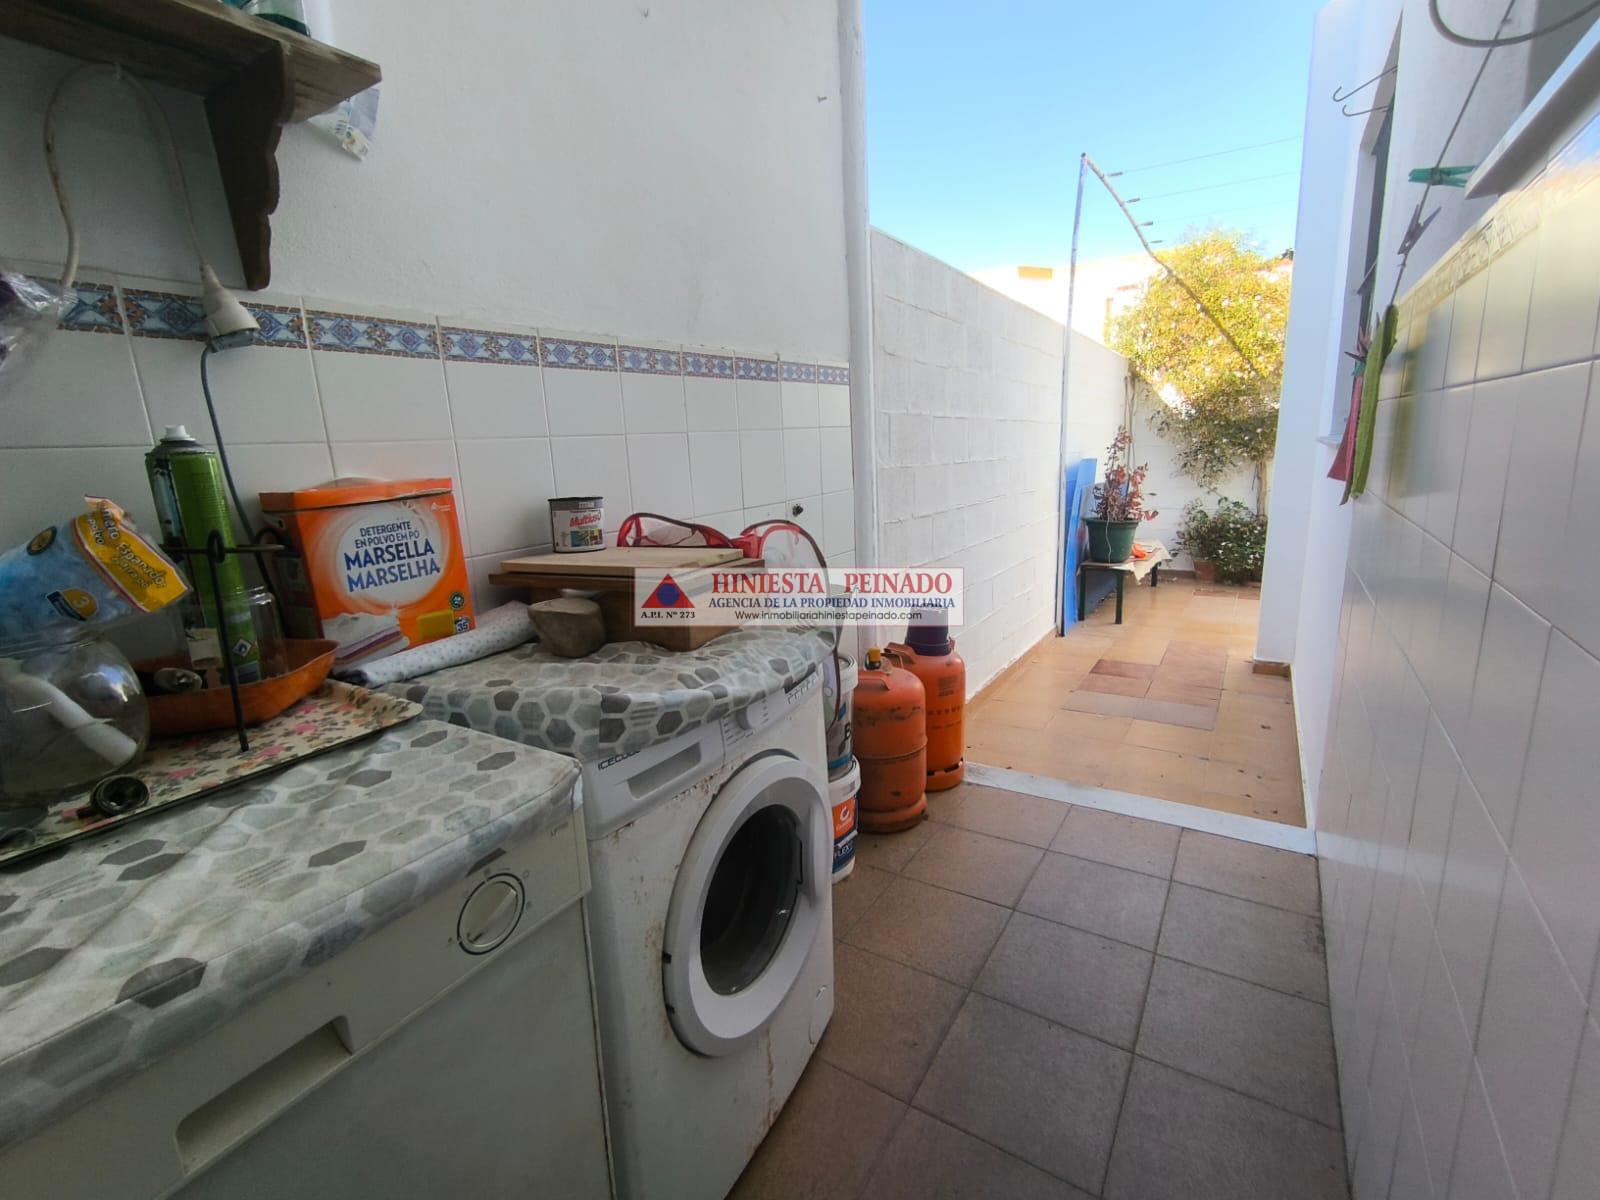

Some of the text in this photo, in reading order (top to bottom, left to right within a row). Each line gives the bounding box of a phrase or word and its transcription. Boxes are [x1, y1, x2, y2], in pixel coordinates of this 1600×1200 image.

[360, 521, 412, 537] DETERGENTE
[355, 538, 367, 549] EN
[368, 534, 396, 546] POLVO
[396, 532, 408, 543] EM
[344, 538, 435, 571] MARSELLA
[347, 557, 441, 593] MARSELHA
[457, 620, 469, 633] 35
